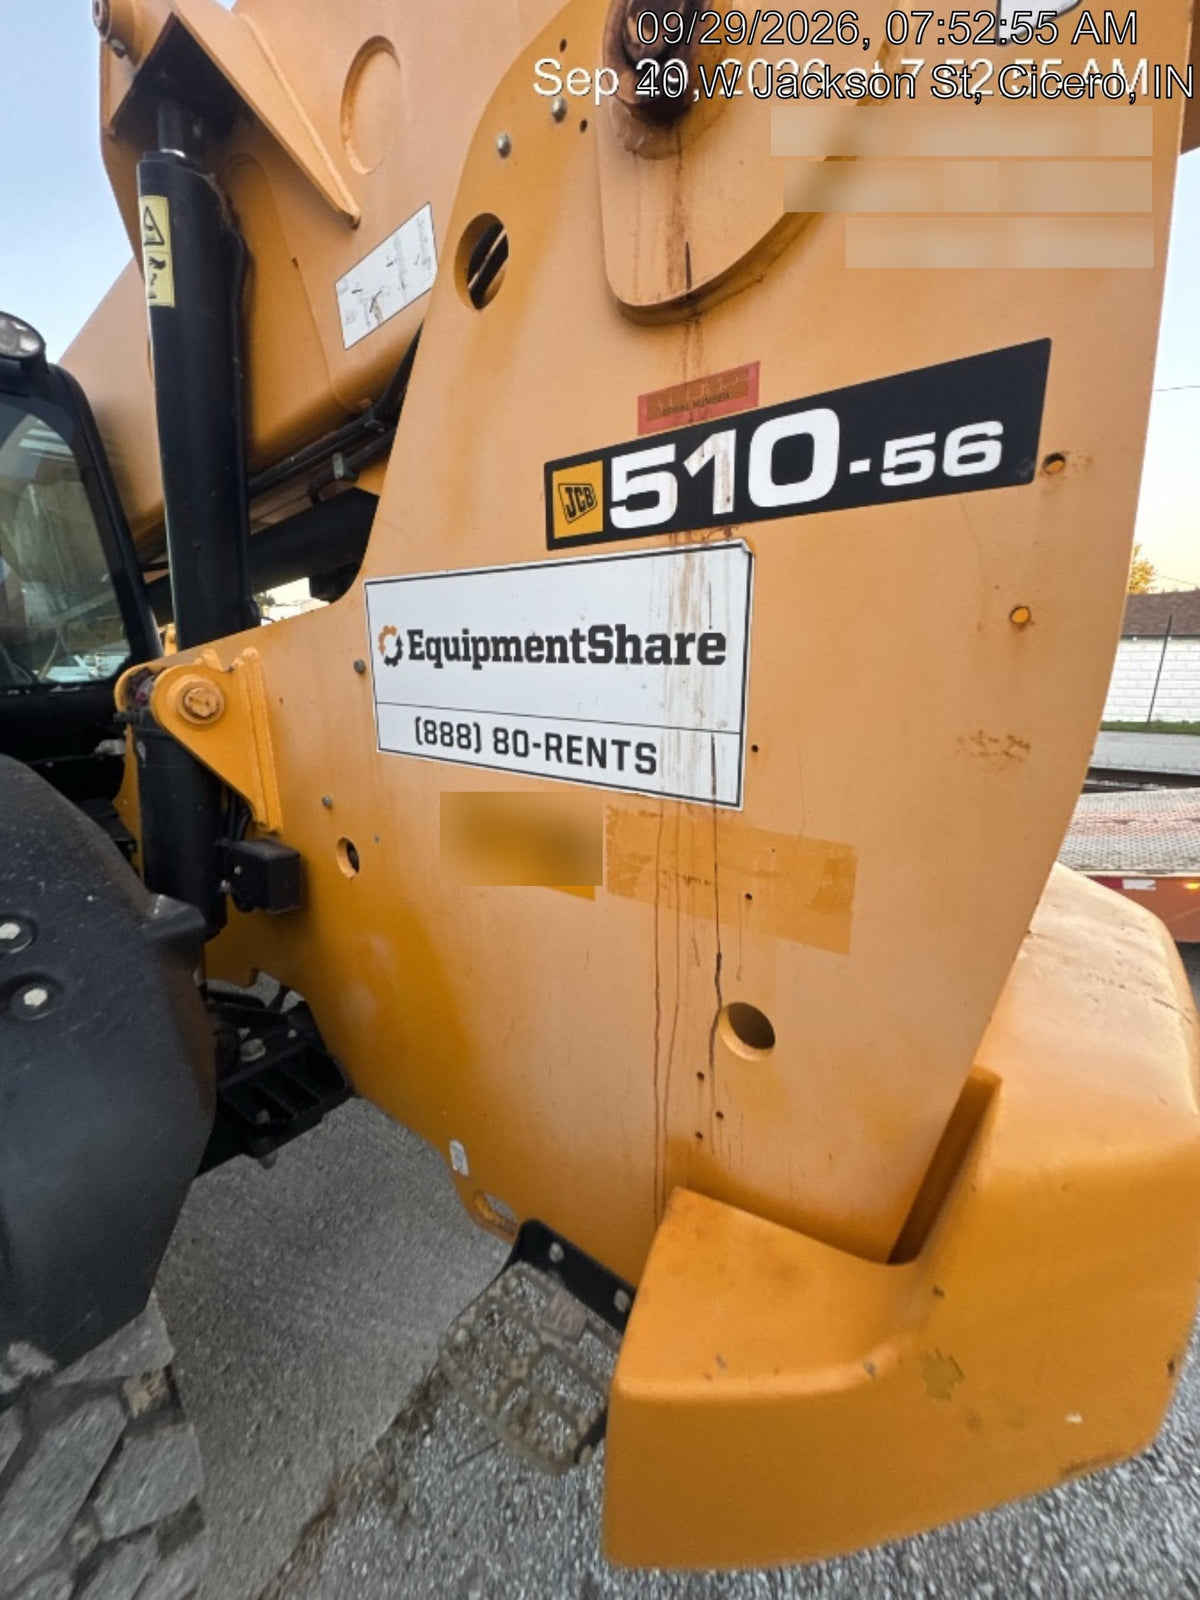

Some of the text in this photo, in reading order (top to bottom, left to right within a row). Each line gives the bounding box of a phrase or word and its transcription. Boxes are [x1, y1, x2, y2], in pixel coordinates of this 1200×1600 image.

[609, 407, 1004, 530] 510-56
[564, 485, 596, 519] JCB
[407, 624, 727, 670] EquipmentShare
[415, 716, 657, 776] (888) 80-RENTS
